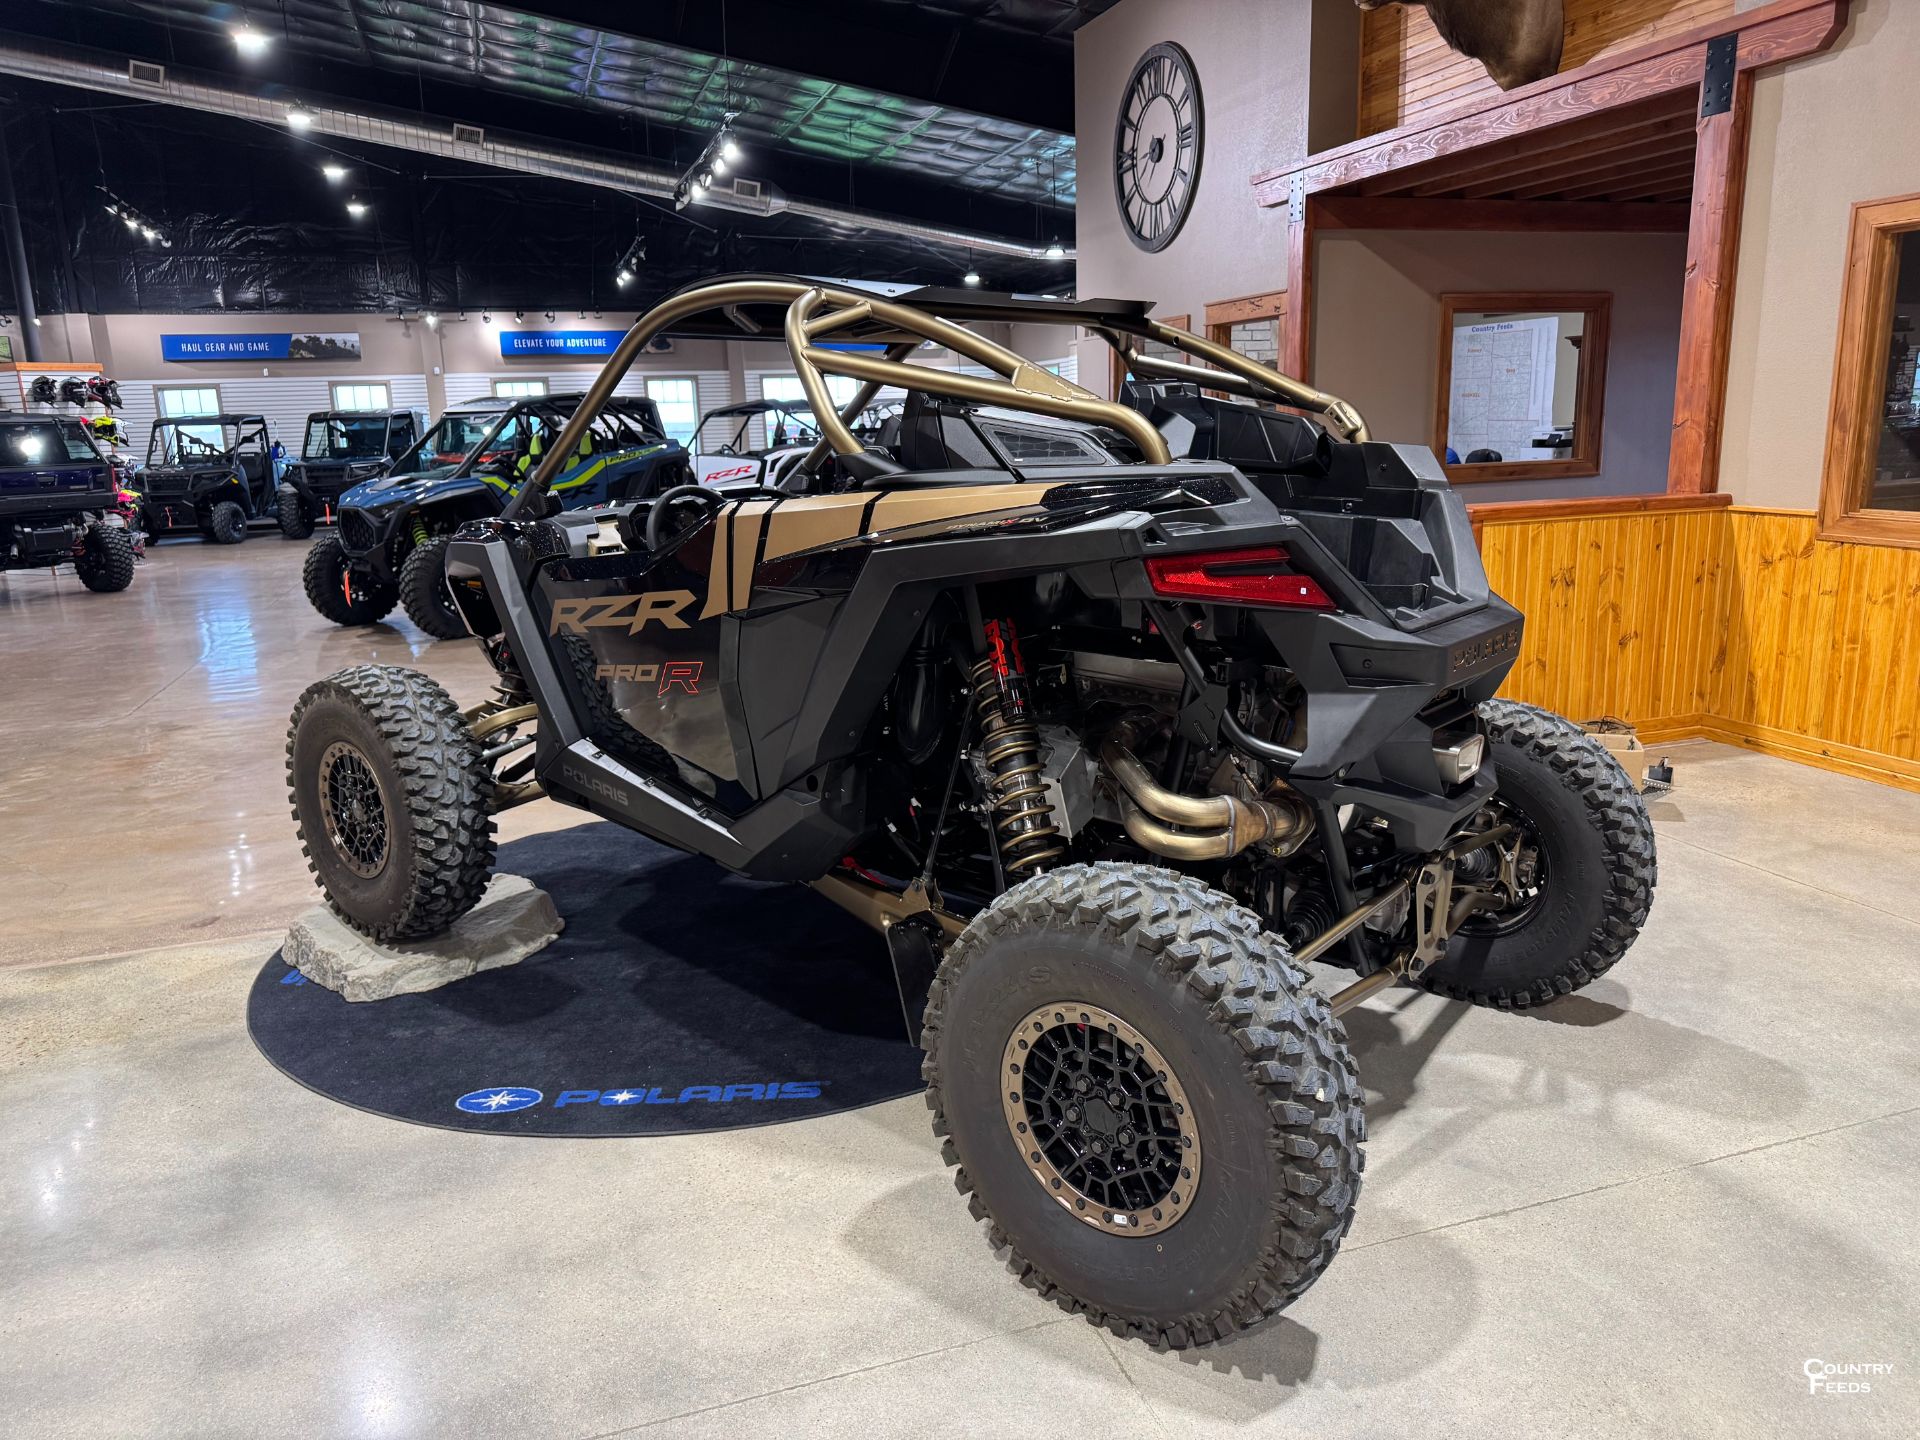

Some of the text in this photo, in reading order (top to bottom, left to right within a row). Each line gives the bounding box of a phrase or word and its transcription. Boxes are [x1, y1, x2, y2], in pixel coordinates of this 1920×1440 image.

[1471, 323, 1513, 333] Country Feeds
[181, 342, 270, 352] HAUL GEAR AND GAME
[513, 338, 607, 348] ELEVATE YOUR ADVENTURE
[704, 465, 752, 483] RZR
[945, 517, 1020, 530] DYNAMIX
[550, 589, 697, 636] RZR
[1452, 626, 1518, 673] POLARIS
[594, 661, 704, 696] PRO R
[562, 764, 630, 807] POLARIS
[553, 1081, 822, 1108] POLARIS
